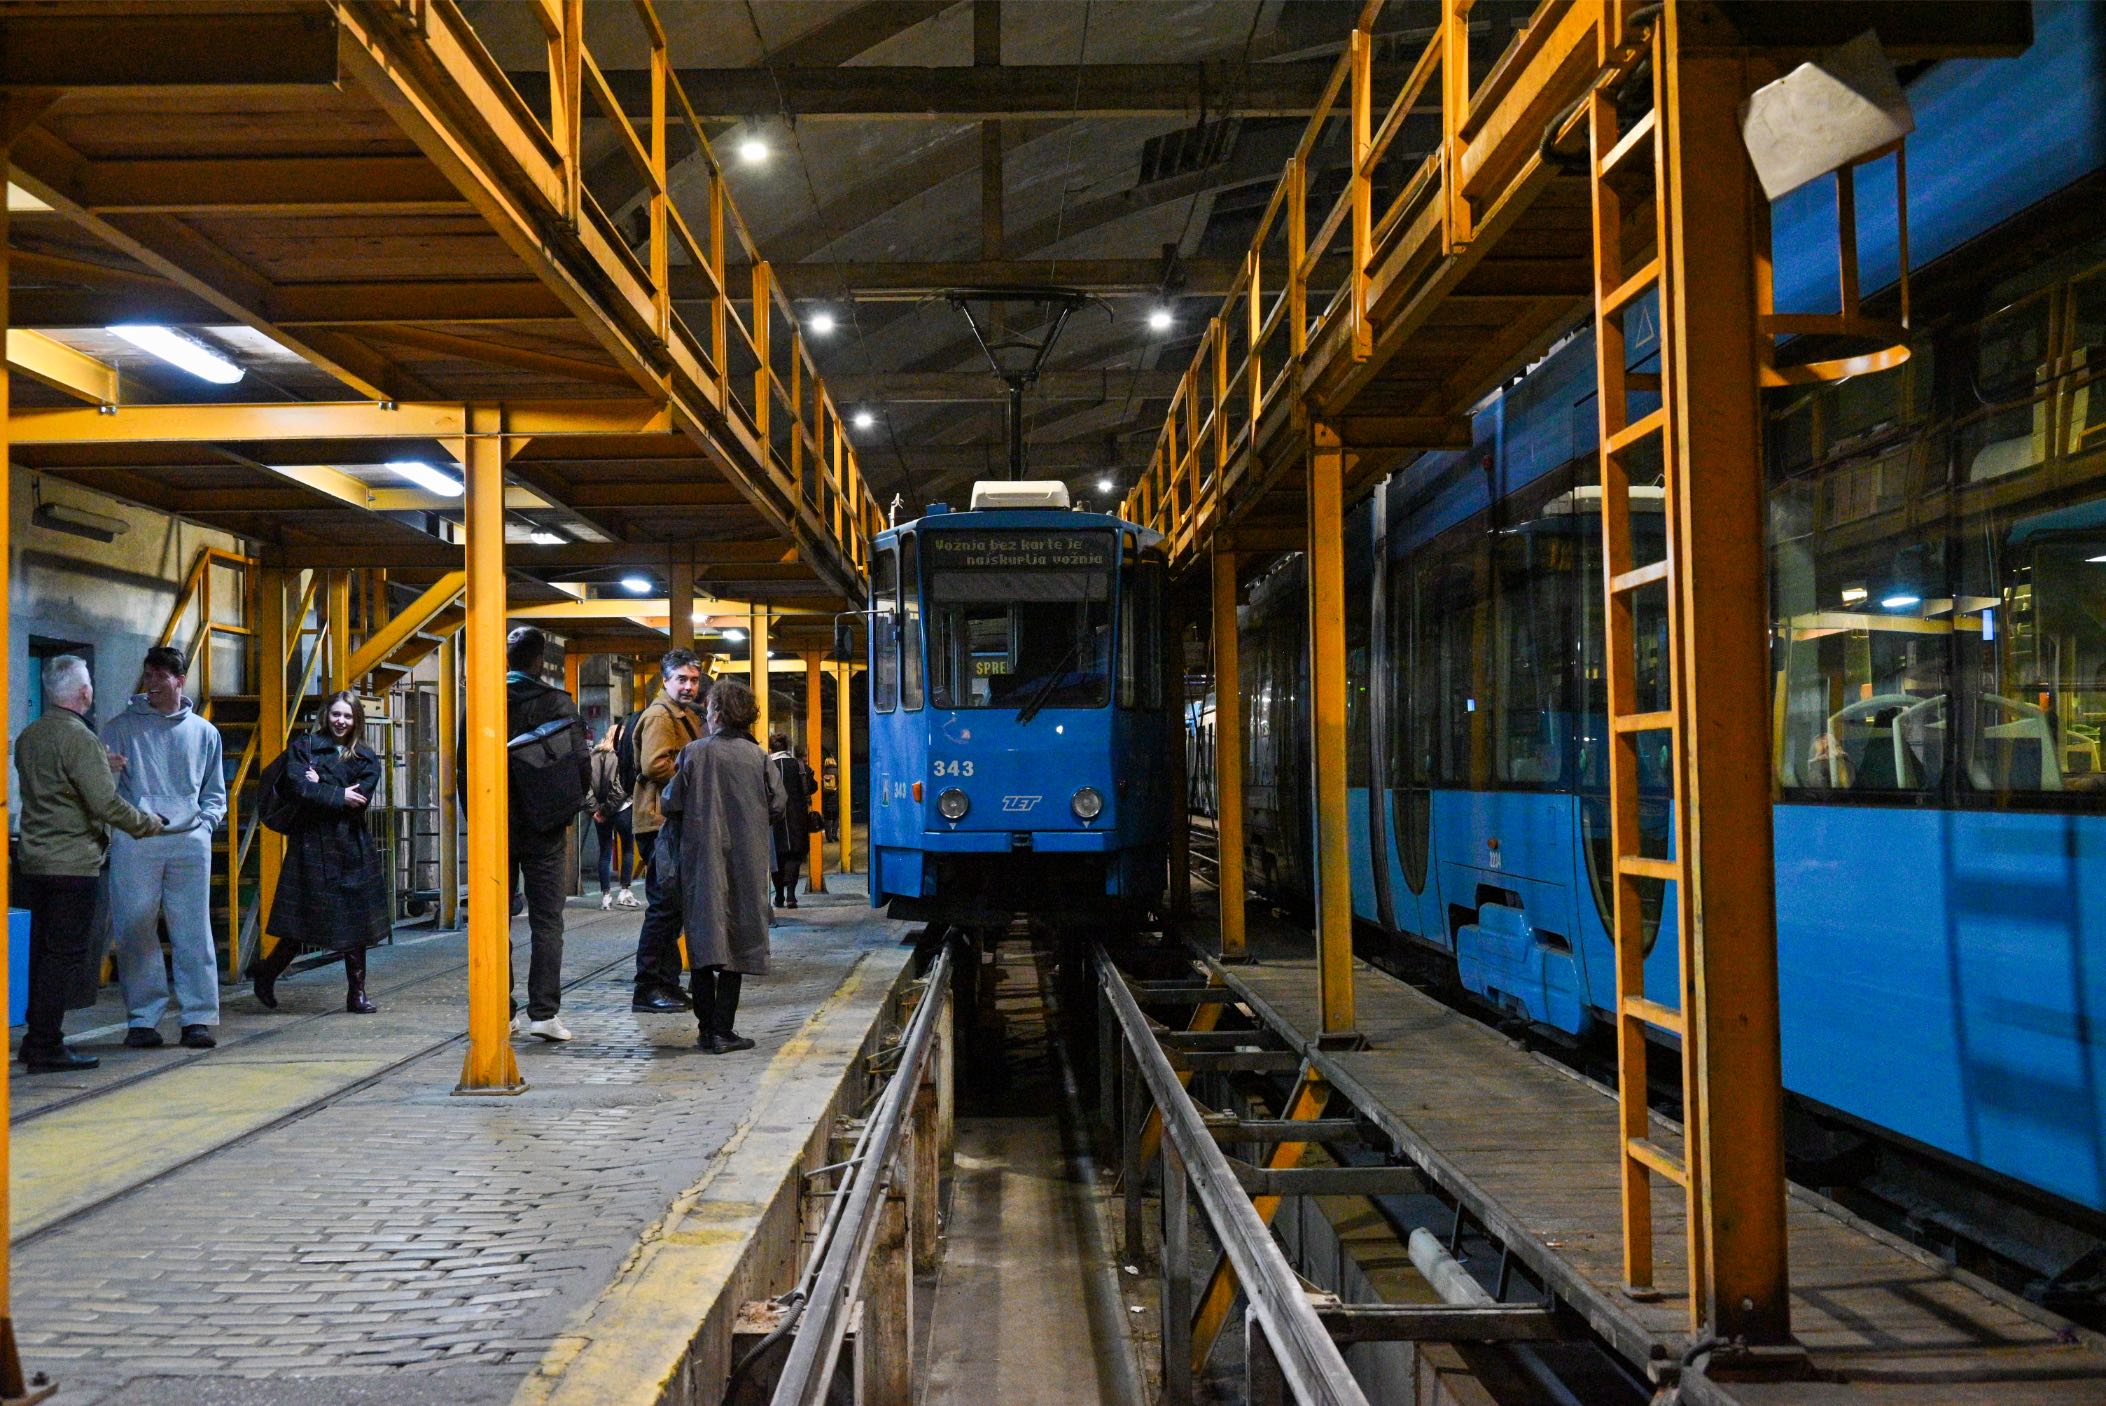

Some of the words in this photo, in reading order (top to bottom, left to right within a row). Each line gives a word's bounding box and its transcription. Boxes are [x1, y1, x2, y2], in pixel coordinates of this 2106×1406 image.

[990, 539, 1017, 551] bez
[1021, 539, 1063, 550] karte
[1053, 551, 1103, 564] vožnja
[933, 760, 974, 777] 343
[894, 781, 907, 799] 343
[1002, 795, 1043, 811] ZET
